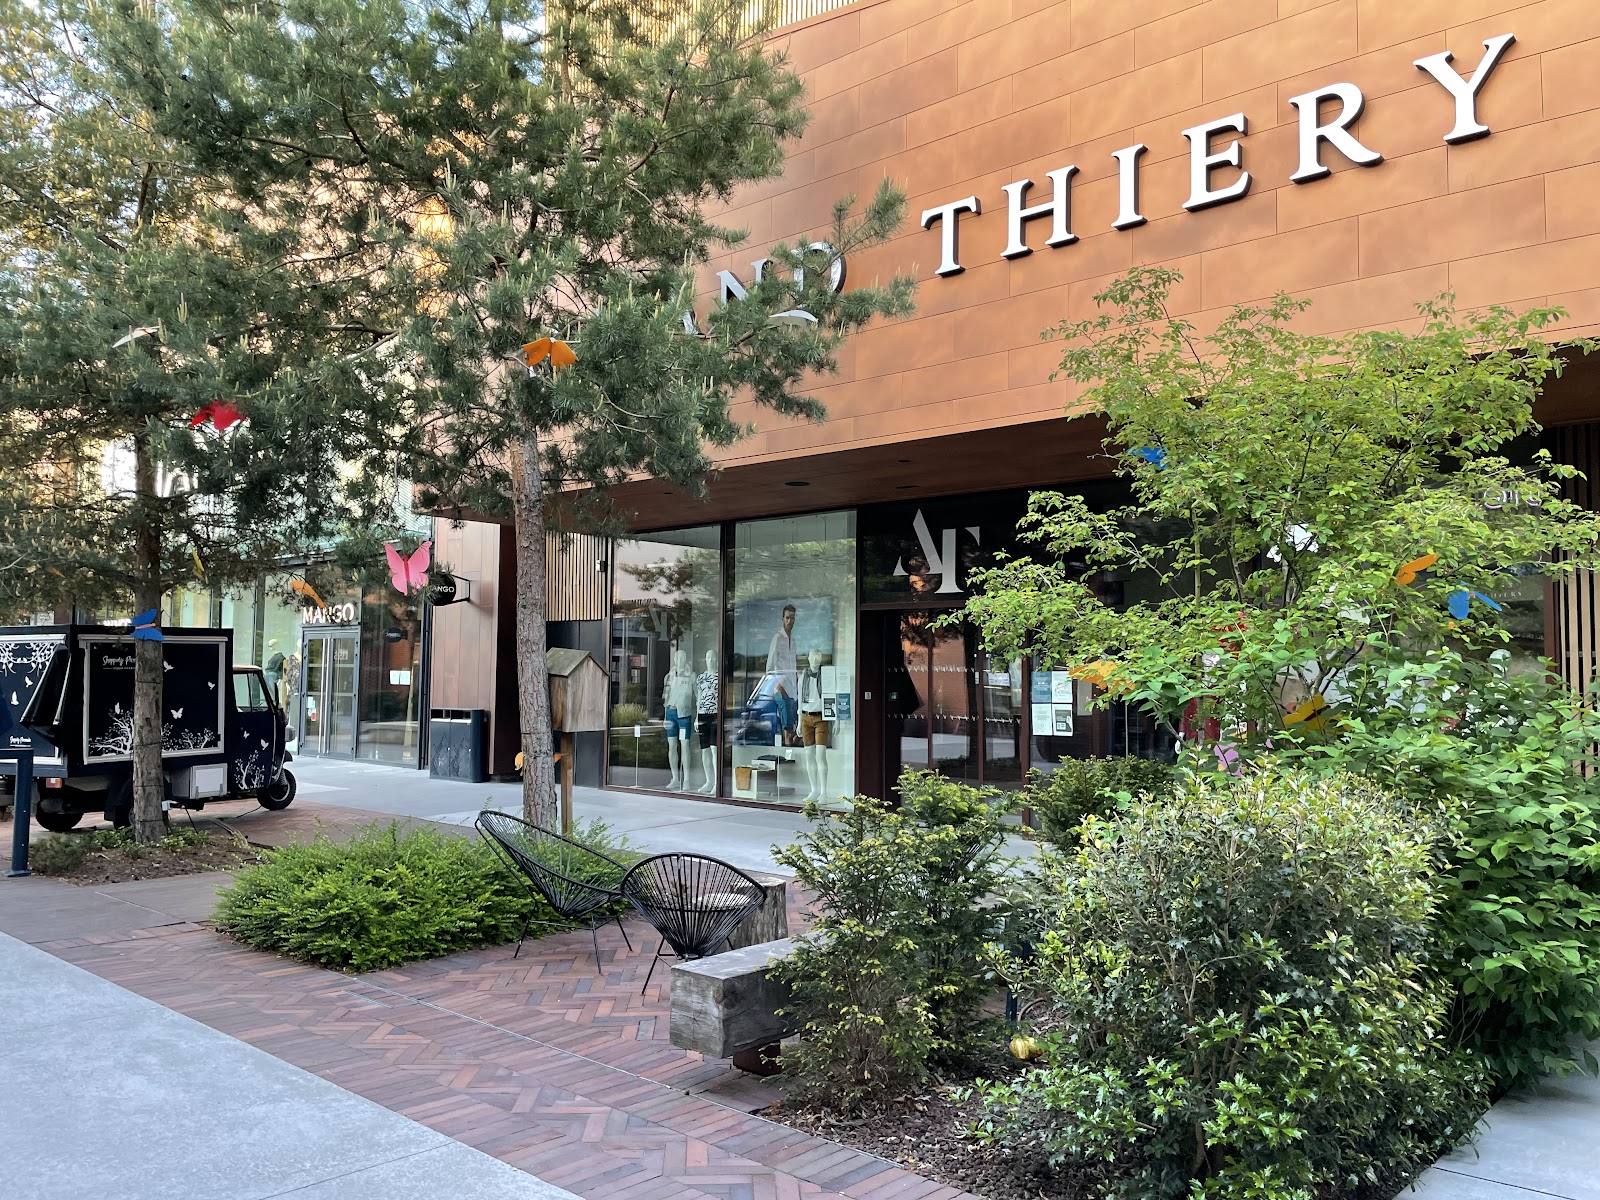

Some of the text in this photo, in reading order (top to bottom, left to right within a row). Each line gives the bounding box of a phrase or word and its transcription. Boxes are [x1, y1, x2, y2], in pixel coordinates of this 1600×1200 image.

[920, 32, 1517, 278] THIERY
[430, 585, 455, 593] ANGO
[302, 602, 355, 625] MANGO
